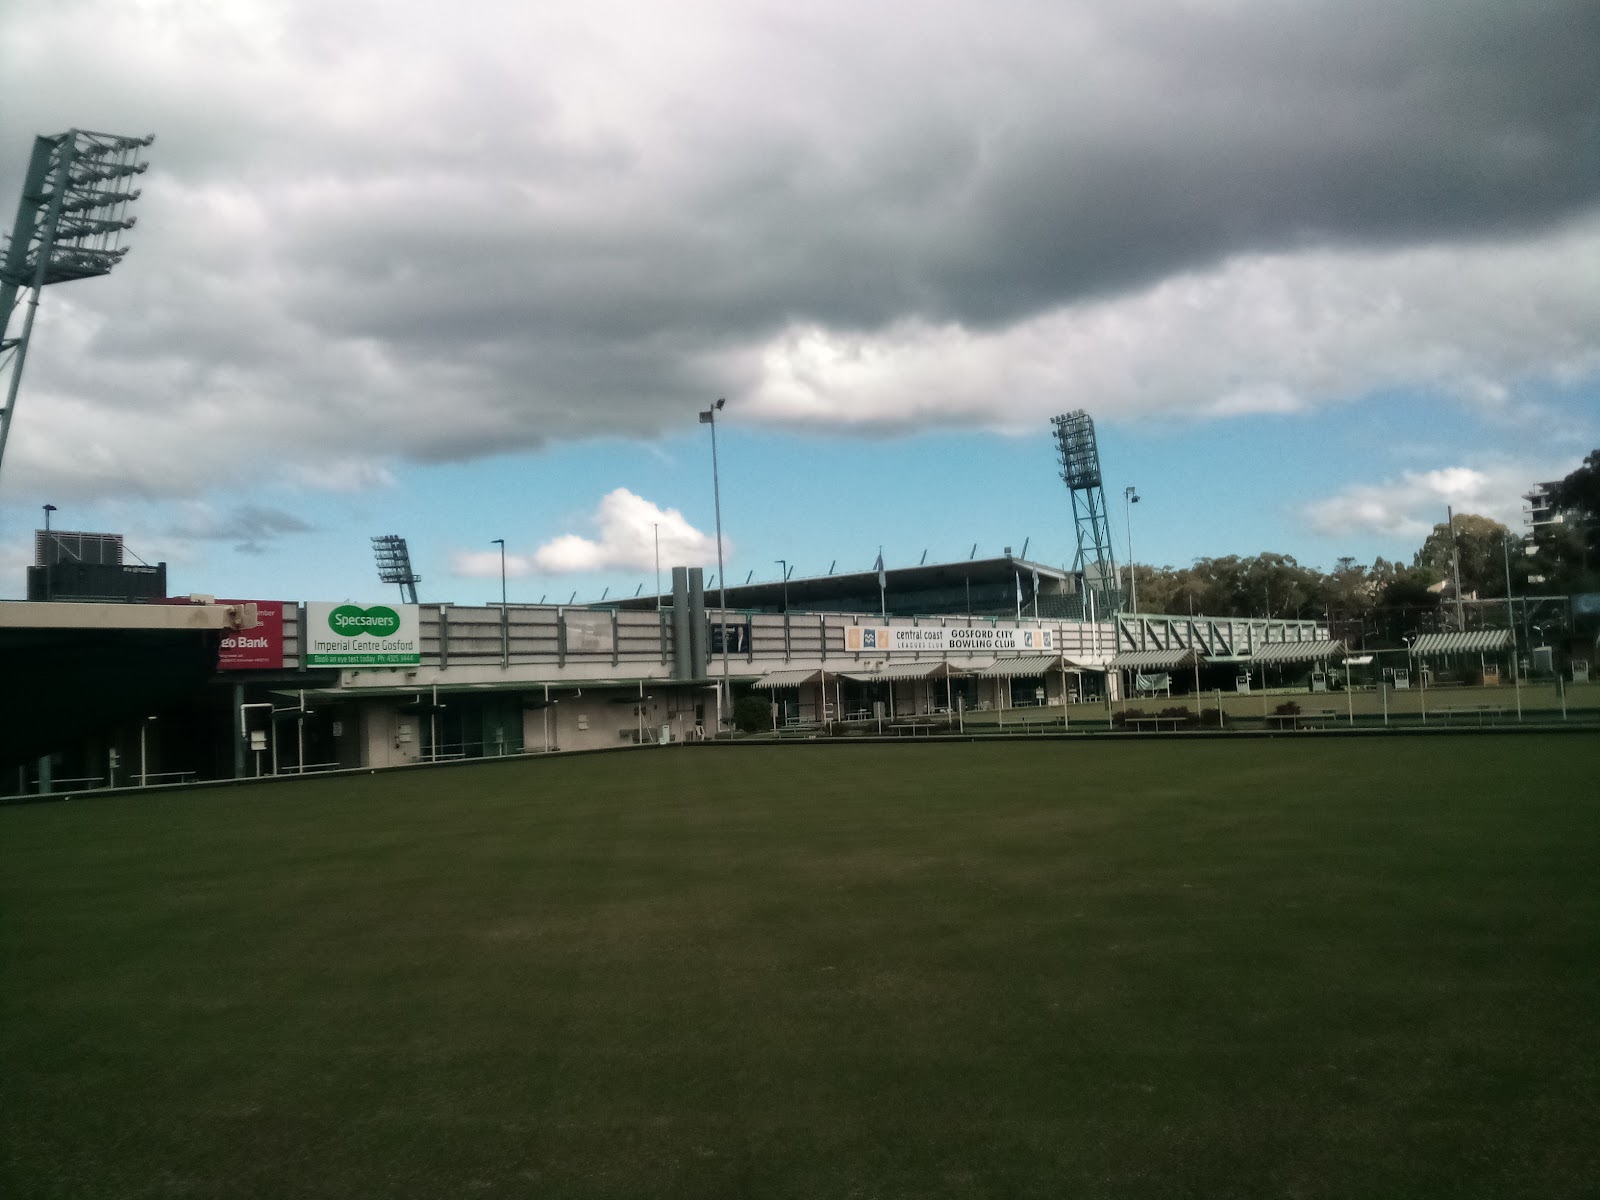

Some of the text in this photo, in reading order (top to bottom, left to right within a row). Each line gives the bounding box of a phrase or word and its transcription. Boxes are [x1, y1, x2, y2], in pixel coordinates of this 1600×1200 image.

[335, 613, 394, 628] Specsavers
[896, 629, 943, 640] central coast
[951, 629, 1013, 640] GOSFORD CITY
[238, 636, 268, 648] Bank
[314, 640, 413, 653] Imperial Centre Gosford
[897, 641, 926, 649] LEAGUES
[949, 639, 1016, 649] BOWLING CLUB
[314, 655, 329, 663] Book
[337, 656, 348, 664] eye
[348, 655, 359, 663] test
[360, 655, 375, 665] today
